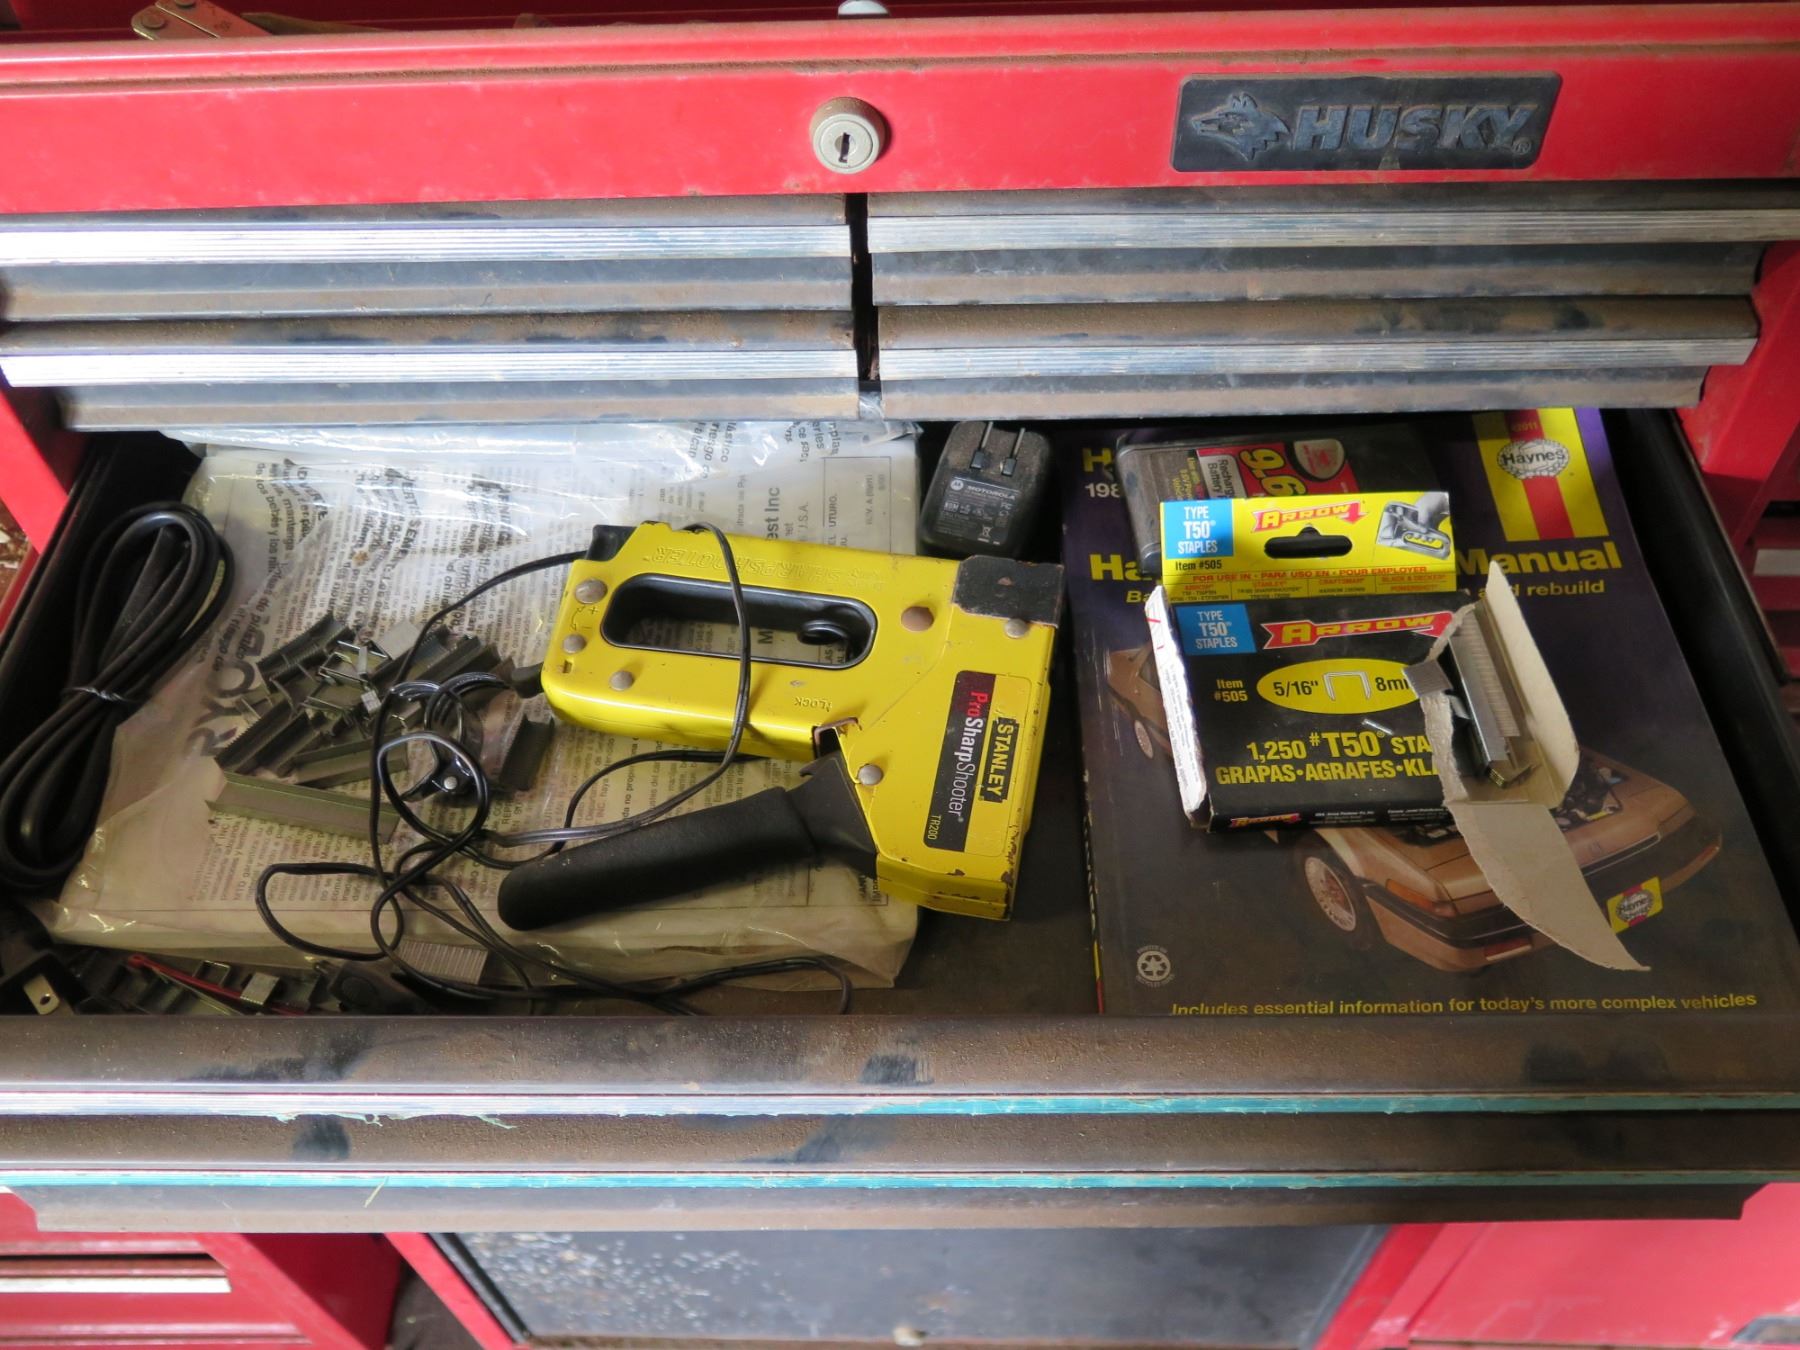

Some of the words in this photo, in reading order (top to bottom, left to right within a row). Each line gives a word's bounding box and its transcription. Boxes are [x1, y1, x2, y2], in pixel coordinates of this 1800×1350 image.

[1295, 104, 1539, 151] HUSKY
[1500, 448, 1566, 466] Haynes
[1207, 462, 1224, 493] Battery
[1240, 448, 1306, 497] 9.6
[764, 487, 781, 514] Inc
[1184, 505, 1209, 520] TYPE
[1260, 504, 1351, 530] ARROW
[1183, 521, 1212, 539] T50
[1177, 540, 1218, 555] STAPLES
[1456, 541, 1622, 575] Manual
[1175, 560, 1196, 571] Item
[1198, 558, 1222, 570] #505
[1192, 574, 1214, 583] FOR
[1217, 573, 1237, 581] USE
[1239, 572, 1251, 580] IN
[1260, 571, 1287, 579] PARA
[1290, 570, 1313, 578] USO
[1339, 568, 1369, 576] POUR
[1371, 566, 1427, 575] EMPLOYER
[1526, 580, 1605, 596] rebuild
[1197, 610, 1223, 621] TYPE
[1199, 622, 1226, 638] T50
[1281, 615, 1434, 644] ARROW
[1194, 637, 1238, 650] STAPLES
[1215, 689, 1248, 702] #505
[1216, 679, 1243, 689] Item
[1272, 679, 1319, 698] 5/16"
[948, 690, 989, 817] ProSharpShooter
[986, 723, 1014, 796] STANLEY
[1246, 740, 1307, 764] 1,250
[1390, 735, 1433, 756] STA
[927, 814, 942, 841] TR200
[1171, 1002, 1249, 1016] Includes
[1253, 1000, 1334, 1015] essential
[1339, 999, 1444, 1015] information
[1449, 997, 1475, 1011] for
[1479, 996, 1545, 1013] today's
[1550, 998, 1597, 1010] more
[1601, 995, 1677, 1012] complex
[1679, 993, 1757, 1009] vehicles
